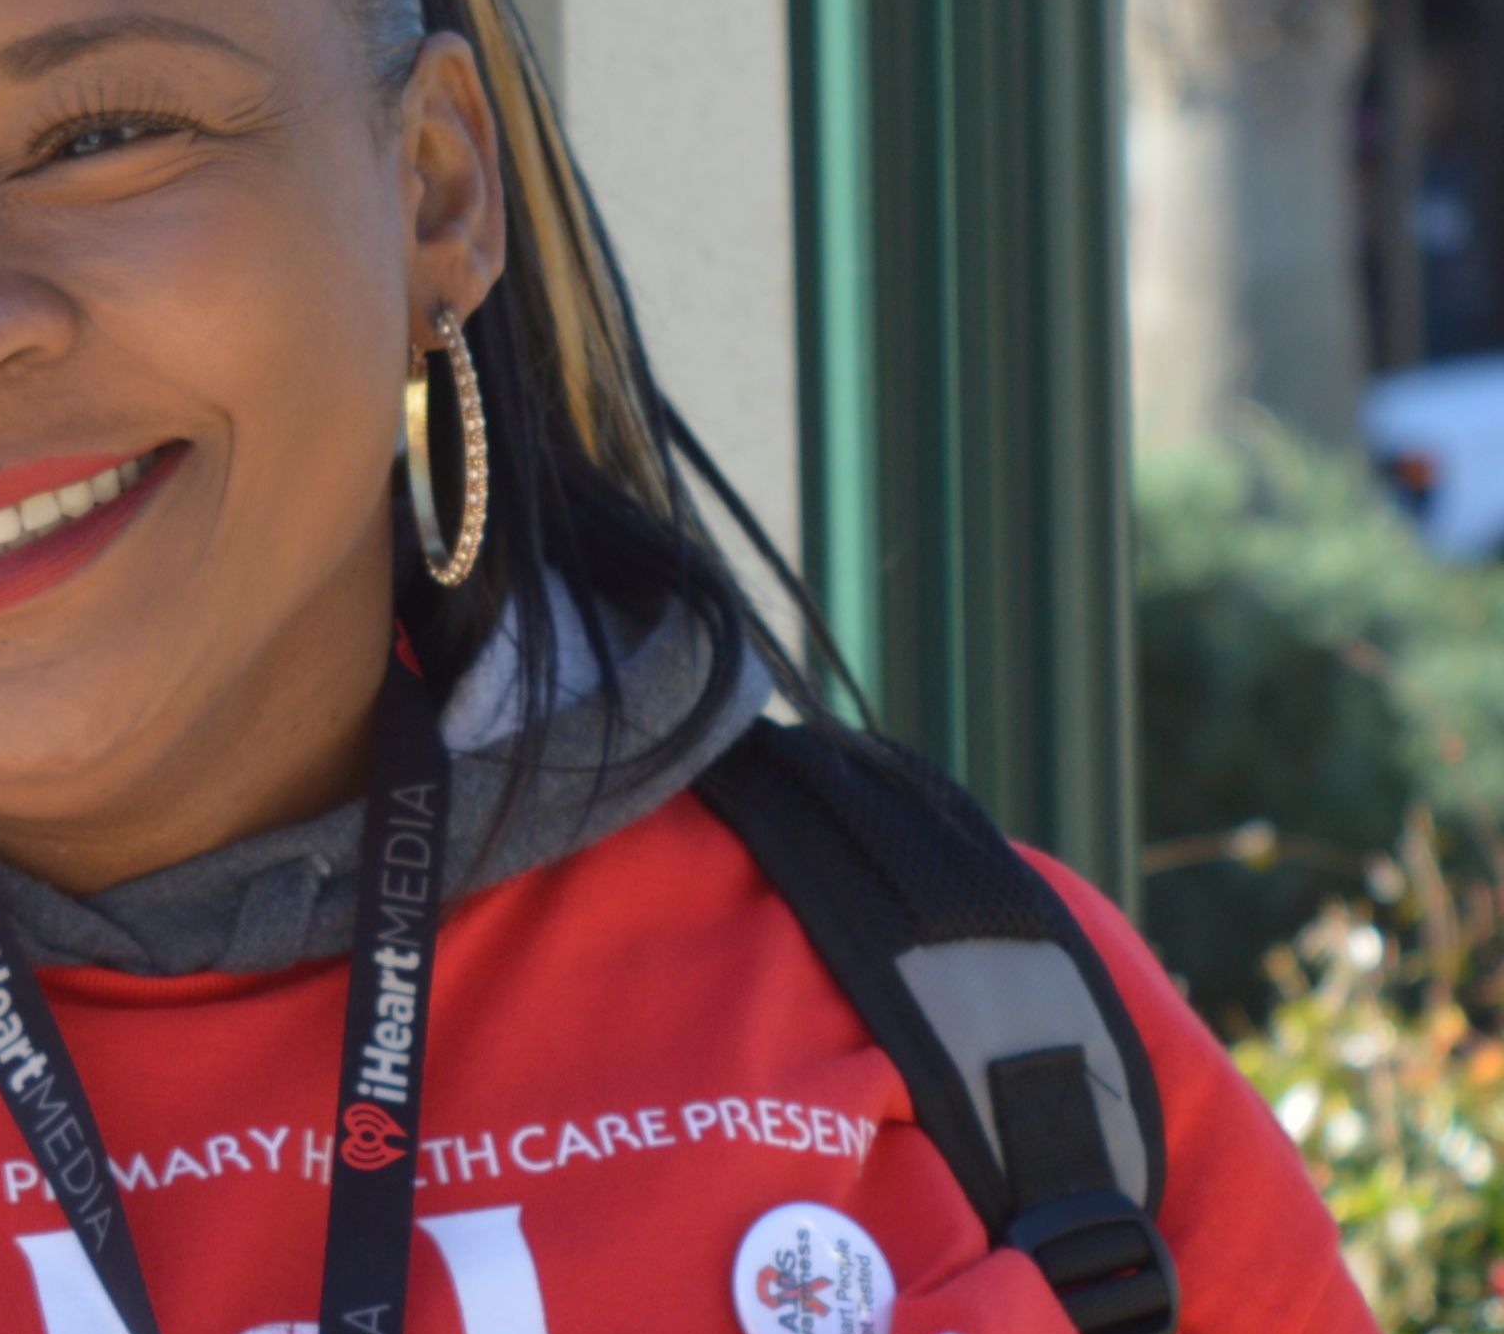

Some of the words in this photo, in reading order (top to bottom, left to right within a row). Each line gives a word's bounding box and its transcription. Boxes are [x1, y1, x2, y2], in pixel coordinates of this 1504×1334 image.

[3, 1125, 290, 1204] PMARY
[509, 1107, 676, 1170] CARE
[774, 1248, 800, 1334] AIDS
